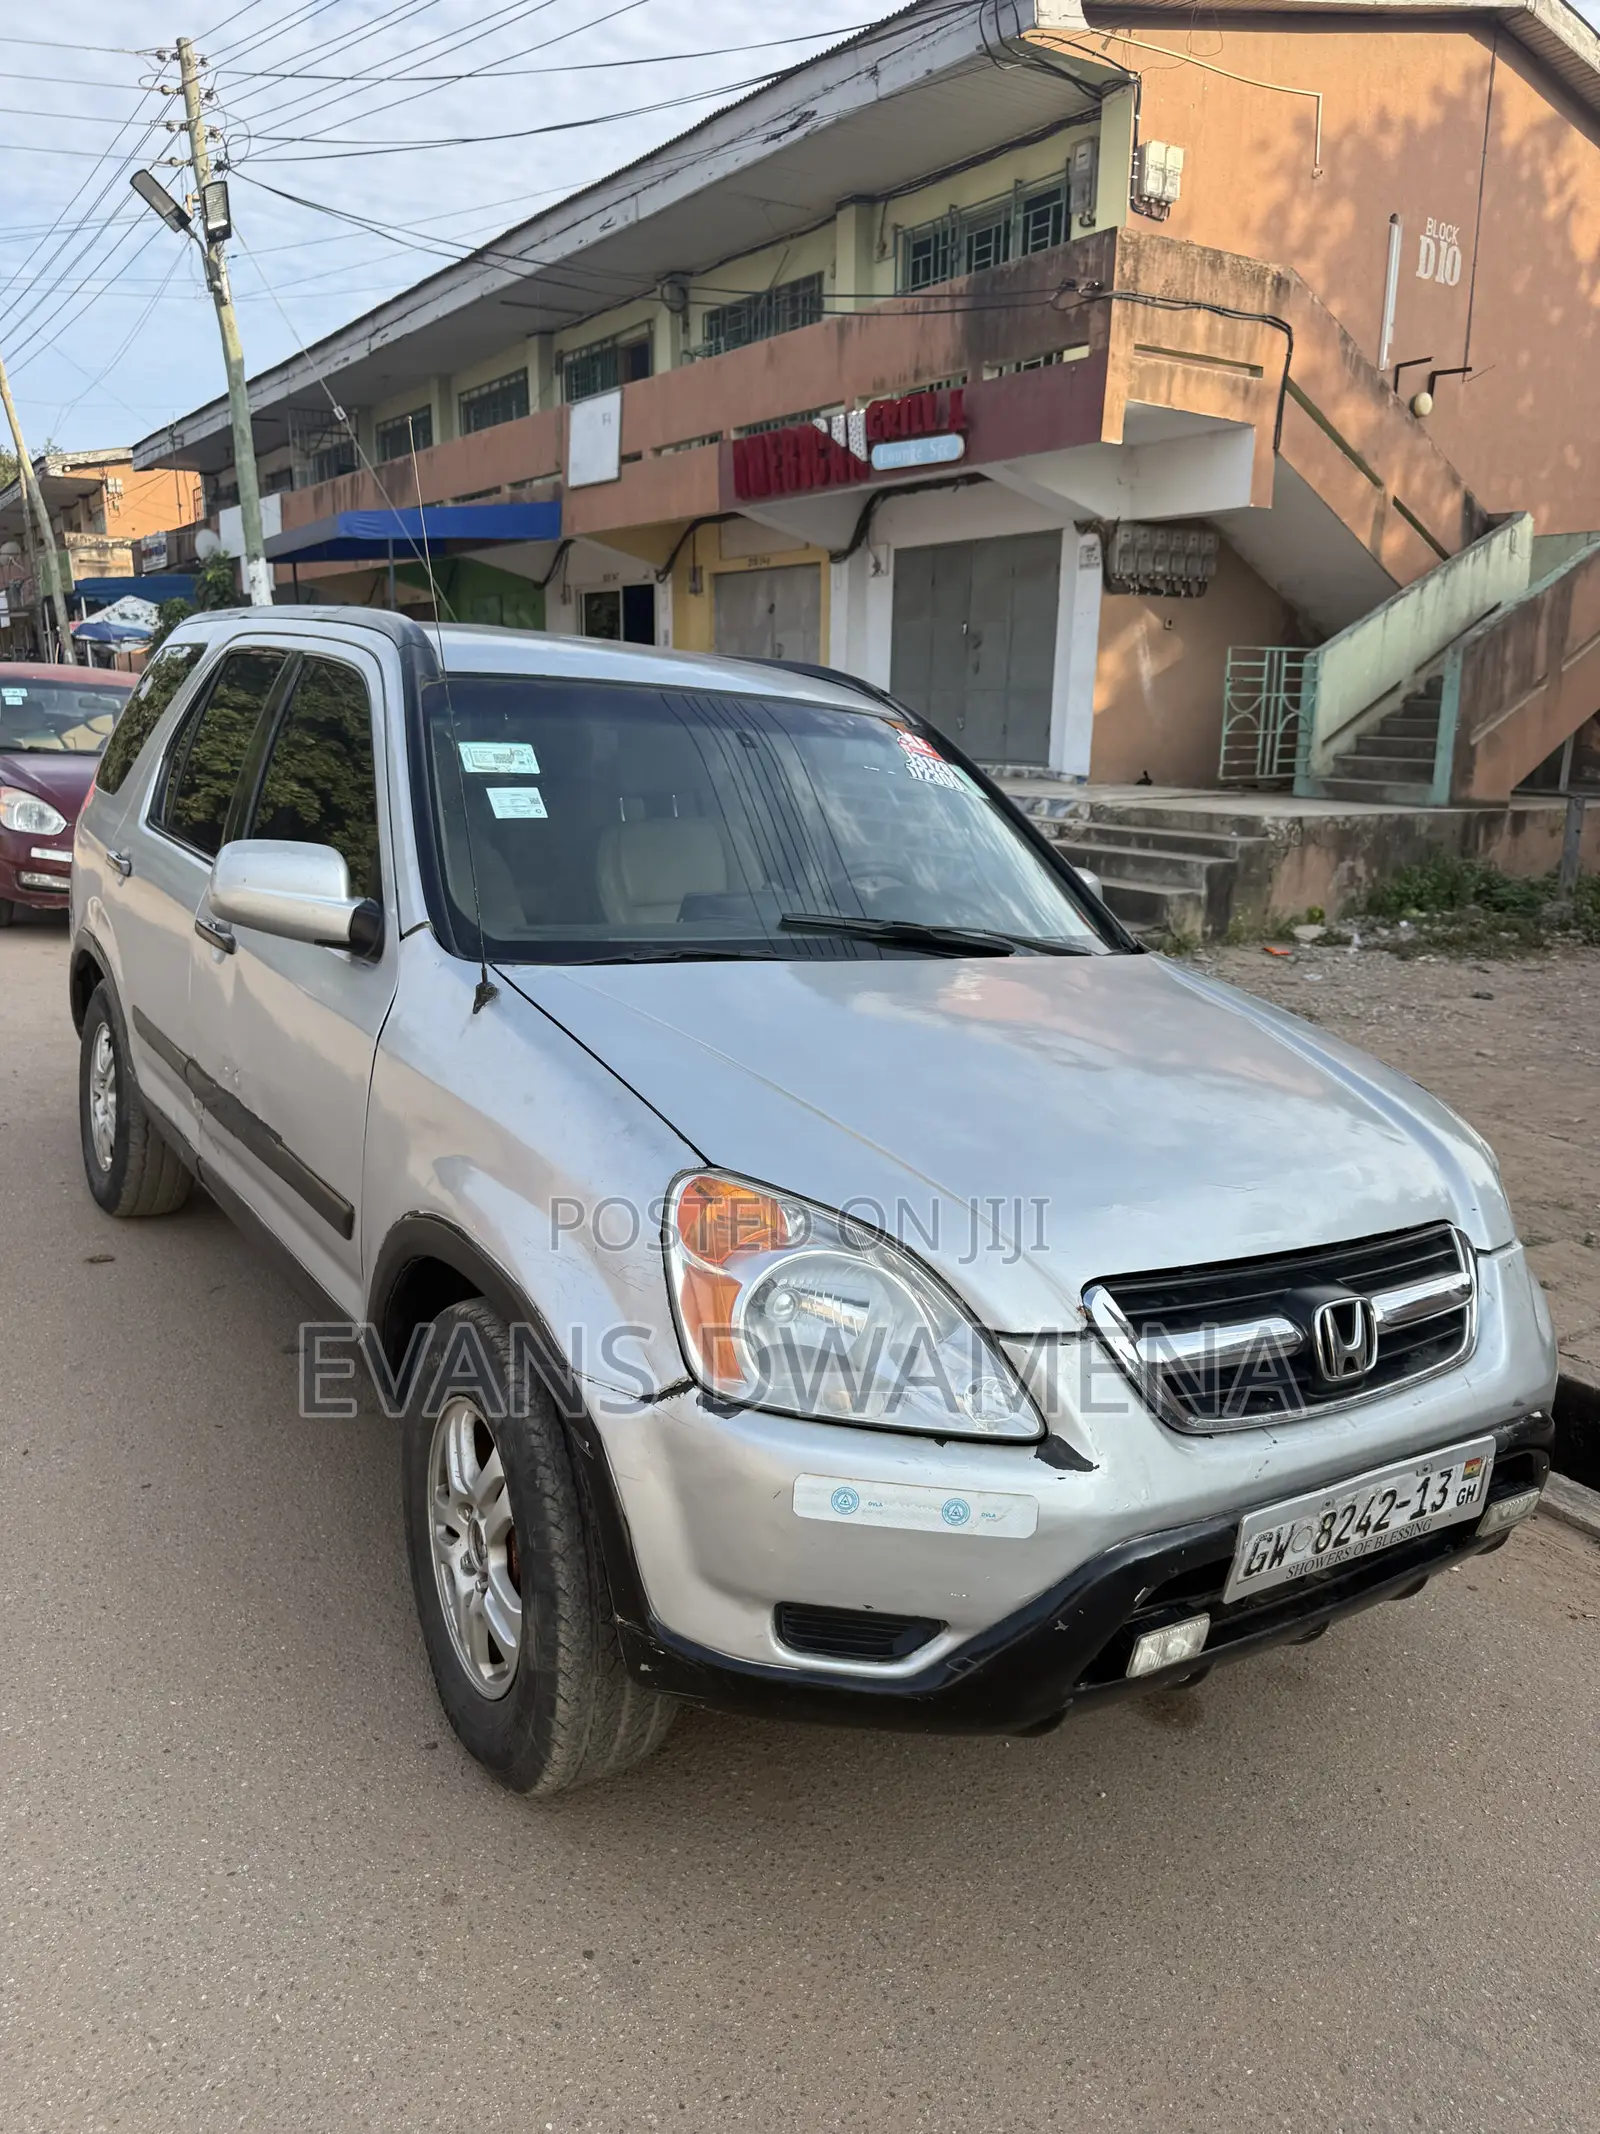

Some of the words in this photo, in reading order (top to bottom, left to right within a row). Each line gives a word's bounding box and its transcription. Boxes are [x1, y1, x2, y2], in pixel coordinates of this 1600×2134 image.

[1426, 217, 1460, 245] BLOCK
[1243, 1524, 1296, 1577] GW
[1313, 1468, 1454, 1554] 8242-13
[1455, 1484, 1478, 1507] GH
[1285, 1547, 1351, 1580] SHOWERS
[1353, 1538, 1372, 1555] OF
[1374, 1518, 1433, 1549] BLESSING
